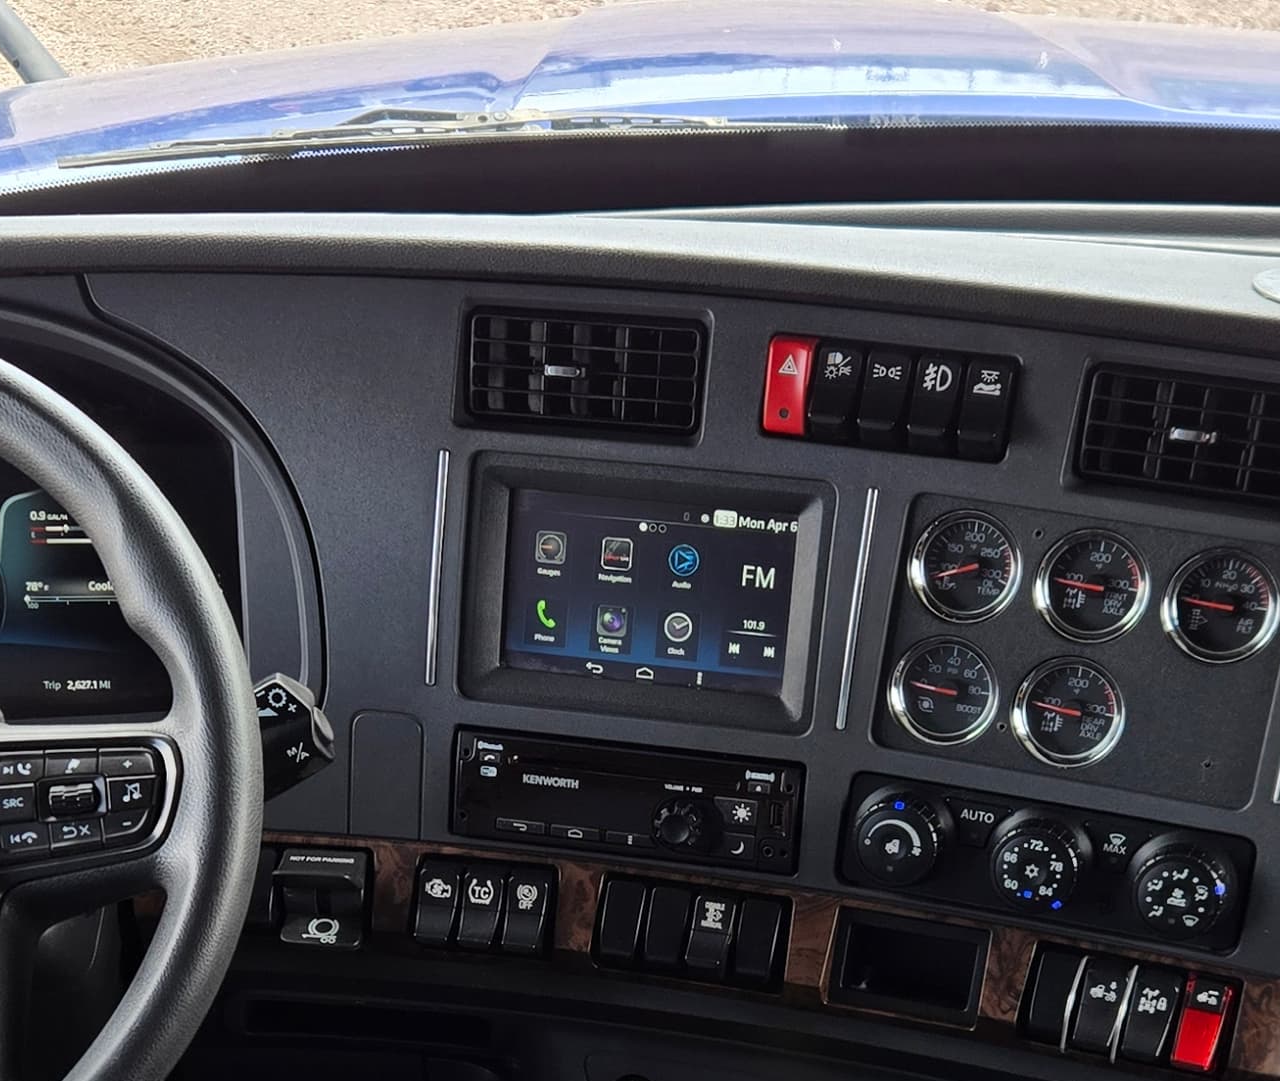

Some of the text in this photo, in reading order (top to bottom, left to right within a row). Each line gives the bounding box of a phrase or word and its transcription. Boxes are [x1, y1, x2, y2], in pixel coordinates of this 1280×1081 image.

[29, 510, 46, 521] 0.9
[739, 516, 765, 530] Mon
[766, 518, 789, 534] Apr
[790, 521, 798, 532] 6
[965, 531, 985, 543] 200
[948, 543, 964, 553] 150
[980, 547, 1000, 558] 250
[1089, 551, 1112, 563] 200
[741, 564, 776, 590] FM
[982, 569, 1002, 579] 300
[1222, 570, 1237, 580] 20
[1109, 580, 1129, 589] 300
[1240, 583, 1255, 594] 30
[977, 586, 1000, 595] TEMP
[1104, 599, 1122, 608] DRV
[1243, 602, 1257, 611] 40
[1102, 606, 1125, 616] AXLE
[743, 619, 765, 631] 101.9
[1239, 618, 1253, 626] AIR
[534, 633, 555, 642] Phone
[947, 656, 960, 666] 40
[928, 664, 942, 673] 20
[963, 669, 977, 679] 60
[43, 680, 111, 691] Trip 2,627.1 MI
[1068, 677, 1089, 688] 200
[968, 685, 981, 695] 80
[956, 704, 982, 714] BOOST
[1087, 703, 1106, 714] 300
[1081, 724, 1099, 733] DRV
[1080, 731, 1101, 740] AXLE
[522, 774, 579, 789] KENWORTH
[2, 797, 24, 809] SRC
[960, 808, 994, 824] AUTO
[1030, 839, 1044, 851] 72
[1103, 843, 1127, 855] MAX
[1003, 852, 1018, 864] 66
[1049, 861, 1064, 872] 78
[1004, 879, 1018, 891] 60
[474, 886, 490, 898] TC
[1039, 885, 1053, 897] 84
[518, 901, 533, 910] OFF
